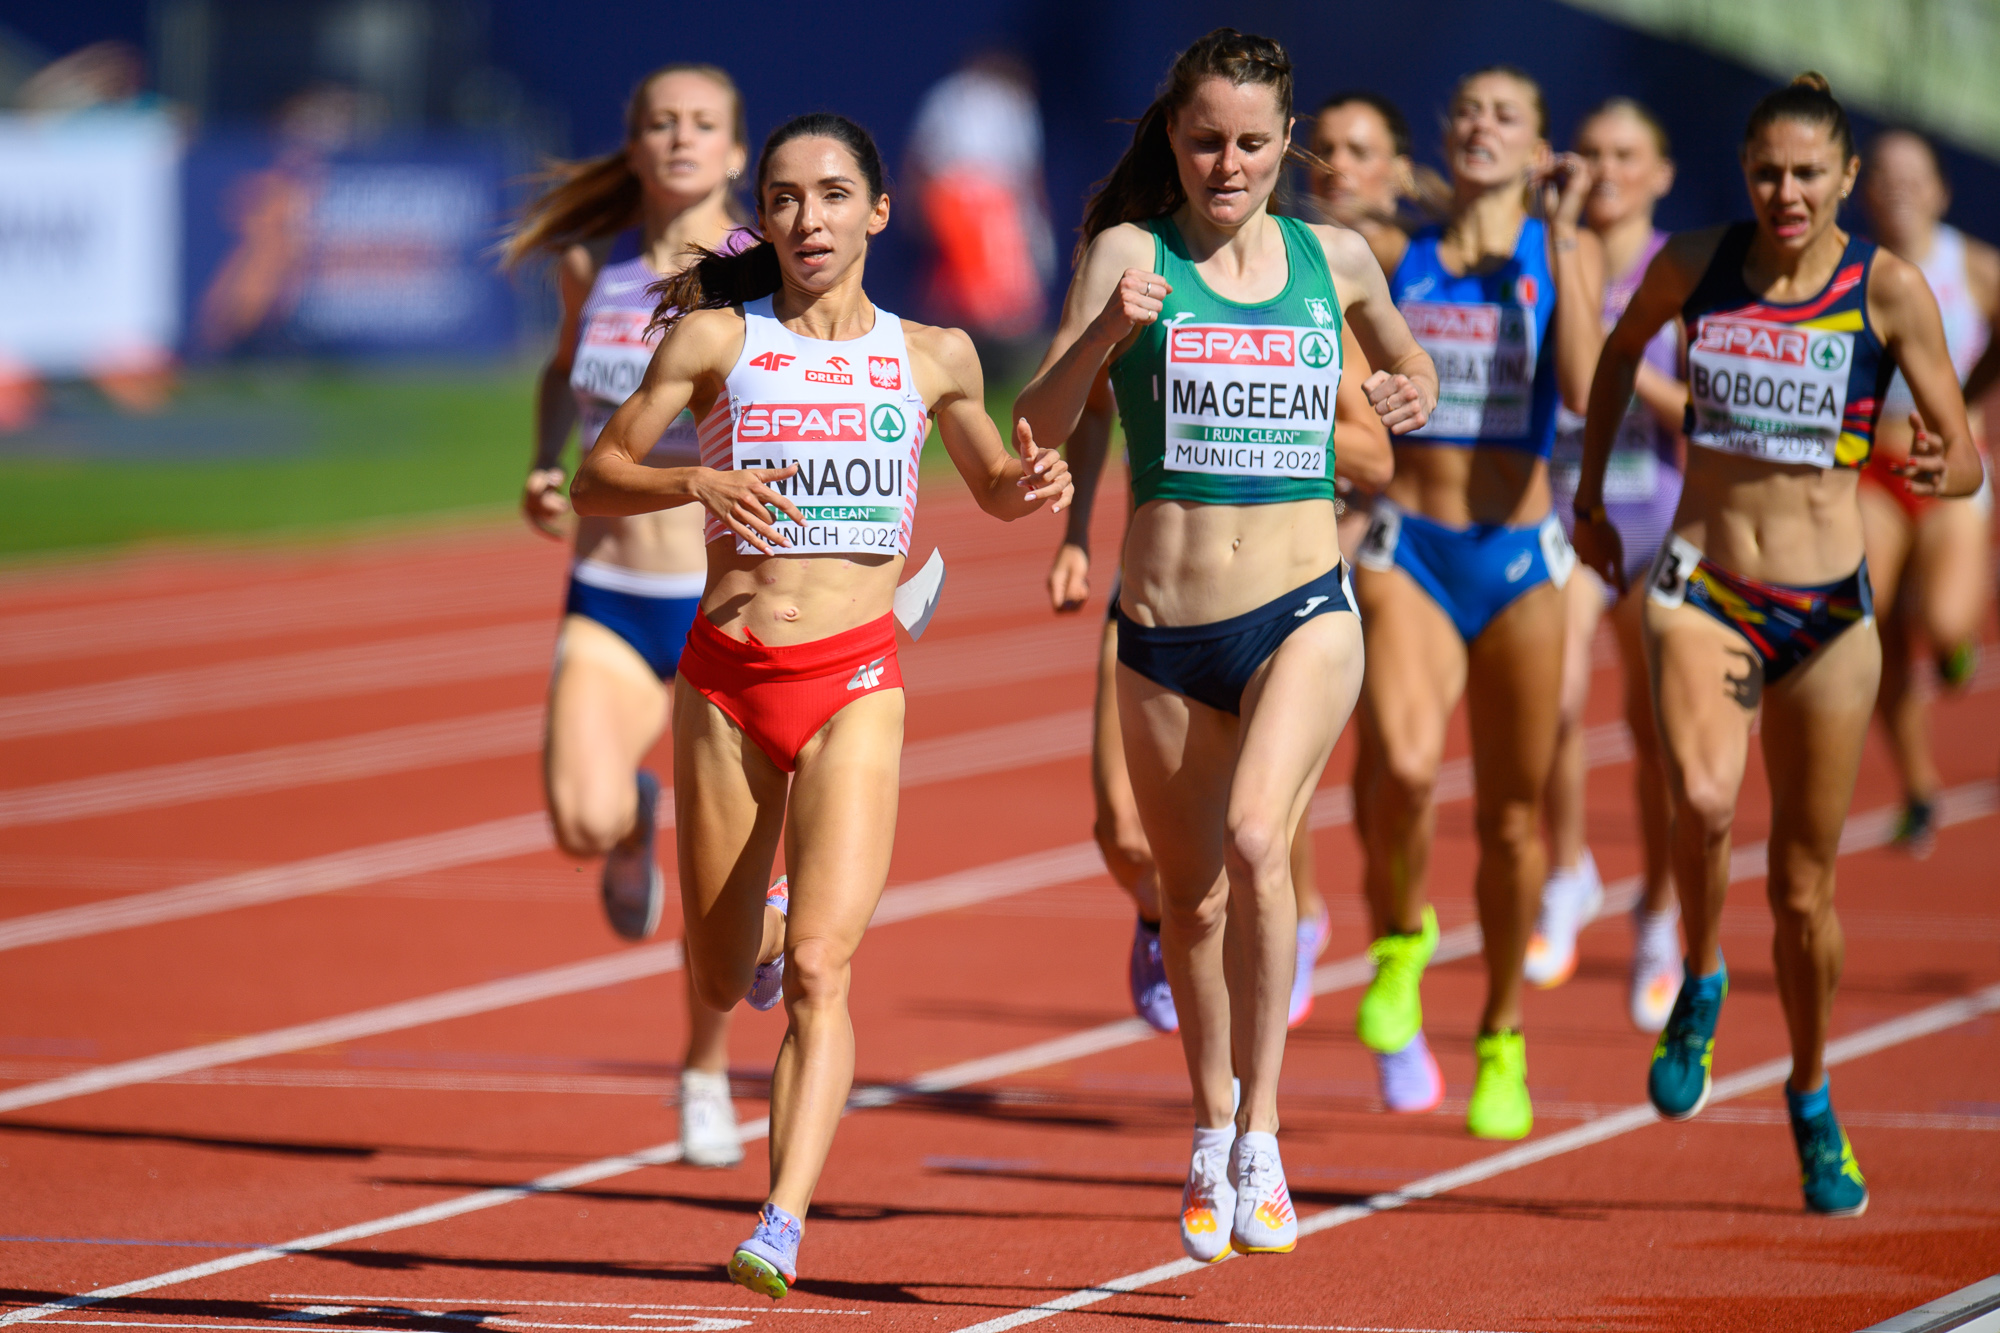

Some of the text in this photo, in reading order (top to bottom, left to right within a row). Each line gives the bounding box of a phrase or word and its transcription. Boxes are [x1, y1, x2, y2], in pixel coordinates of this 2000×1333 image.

[1174, 331, 1292, 362] SPAR
[1701, 323, 1805, 362] SPAR
[584, 357, 646, 393] SNO
[749, 351, 797, 371] 4F
[807, 371, 851, 384] ORLEN
[1694, 364, 1837, 420] BOBOCEA
[1172, 379, 1329, 421] MAGEEAN
[741, 408, 863, 437] SPAR
[1204, 427, 1209, 440] I
[1213, 427, 1245, 442] RUN
[1175, 444, 1321, 471] MUNICH 2022
[848, 527, 897, 548] 2022
[846, 656, 886, 690] 4F
